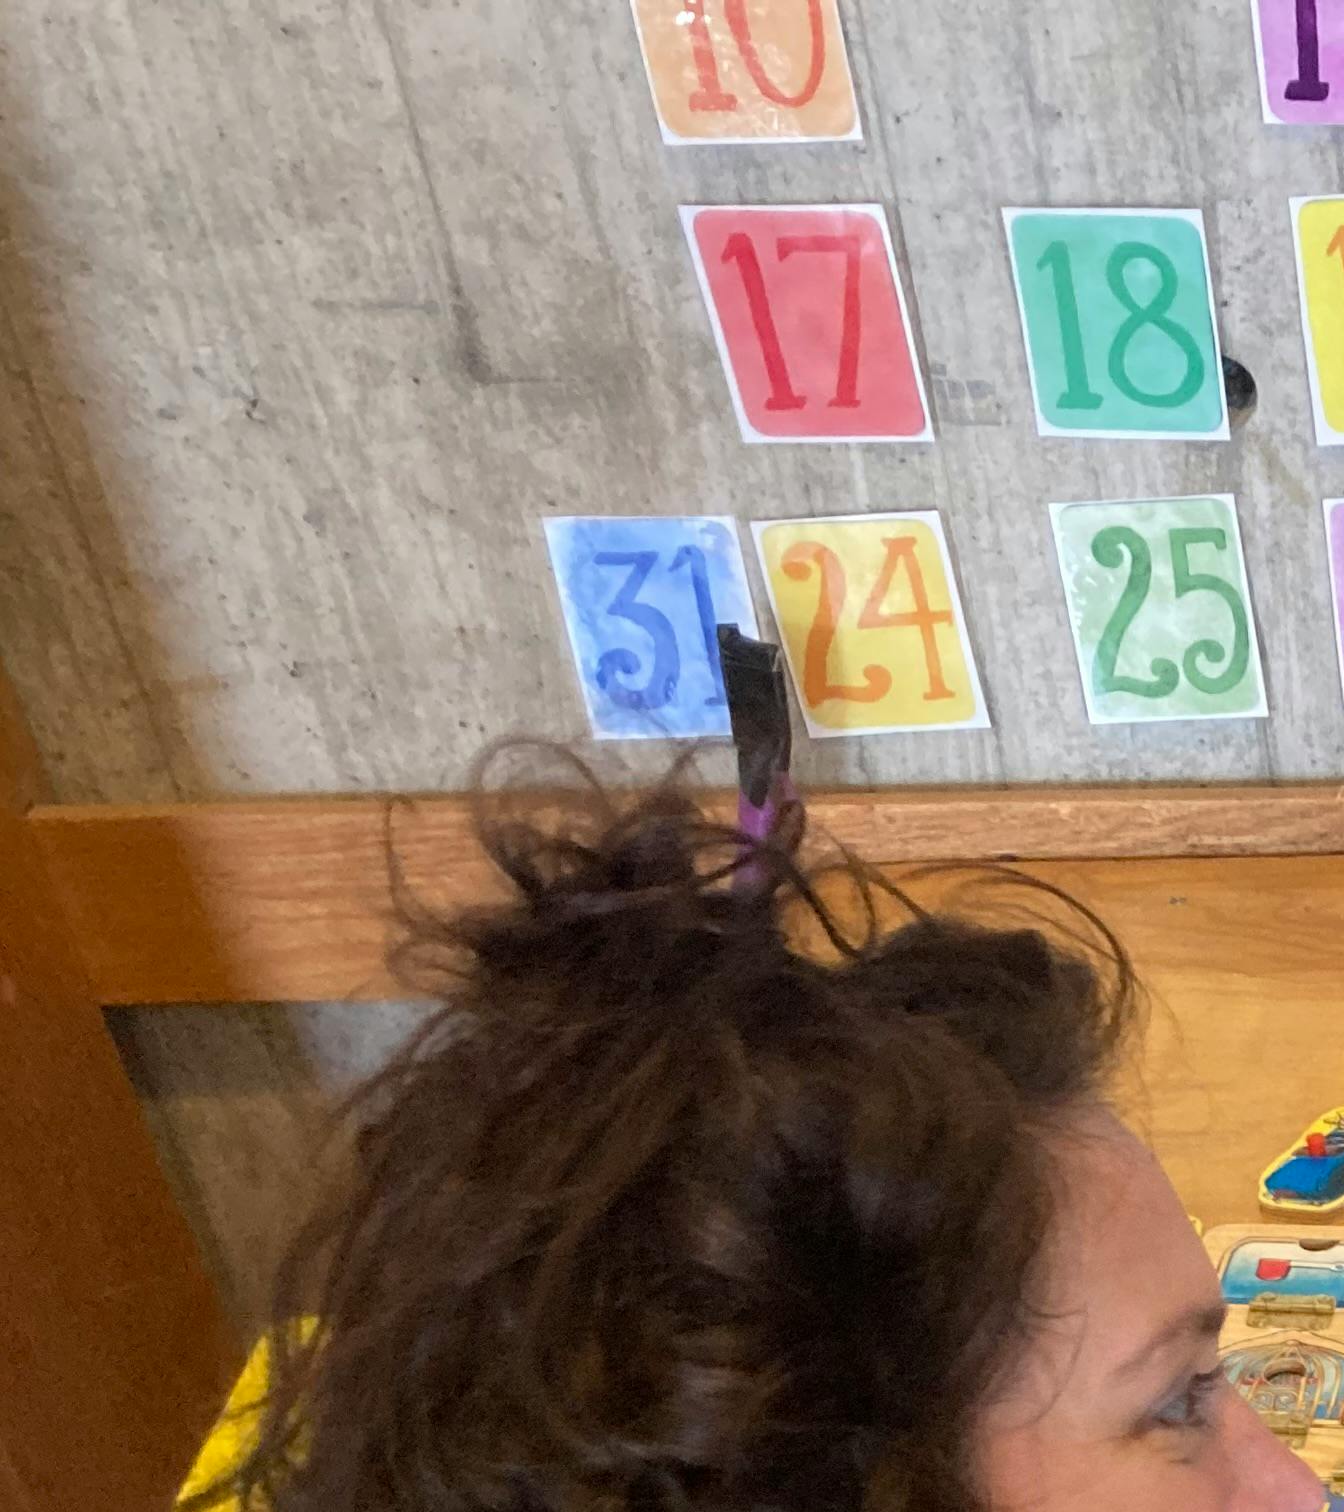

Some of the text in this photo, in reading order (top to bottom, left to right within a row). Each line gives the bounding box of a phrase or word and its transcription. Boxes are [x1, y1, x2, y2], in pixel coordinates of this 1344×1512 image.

[722, 232, 861, 411] 17
[1036, 241, 1205, 410] 18
[594, 544, 729, 712] 31
[782, 536, 954, 708] 24
[1091, 526, 1250, 697] 25
